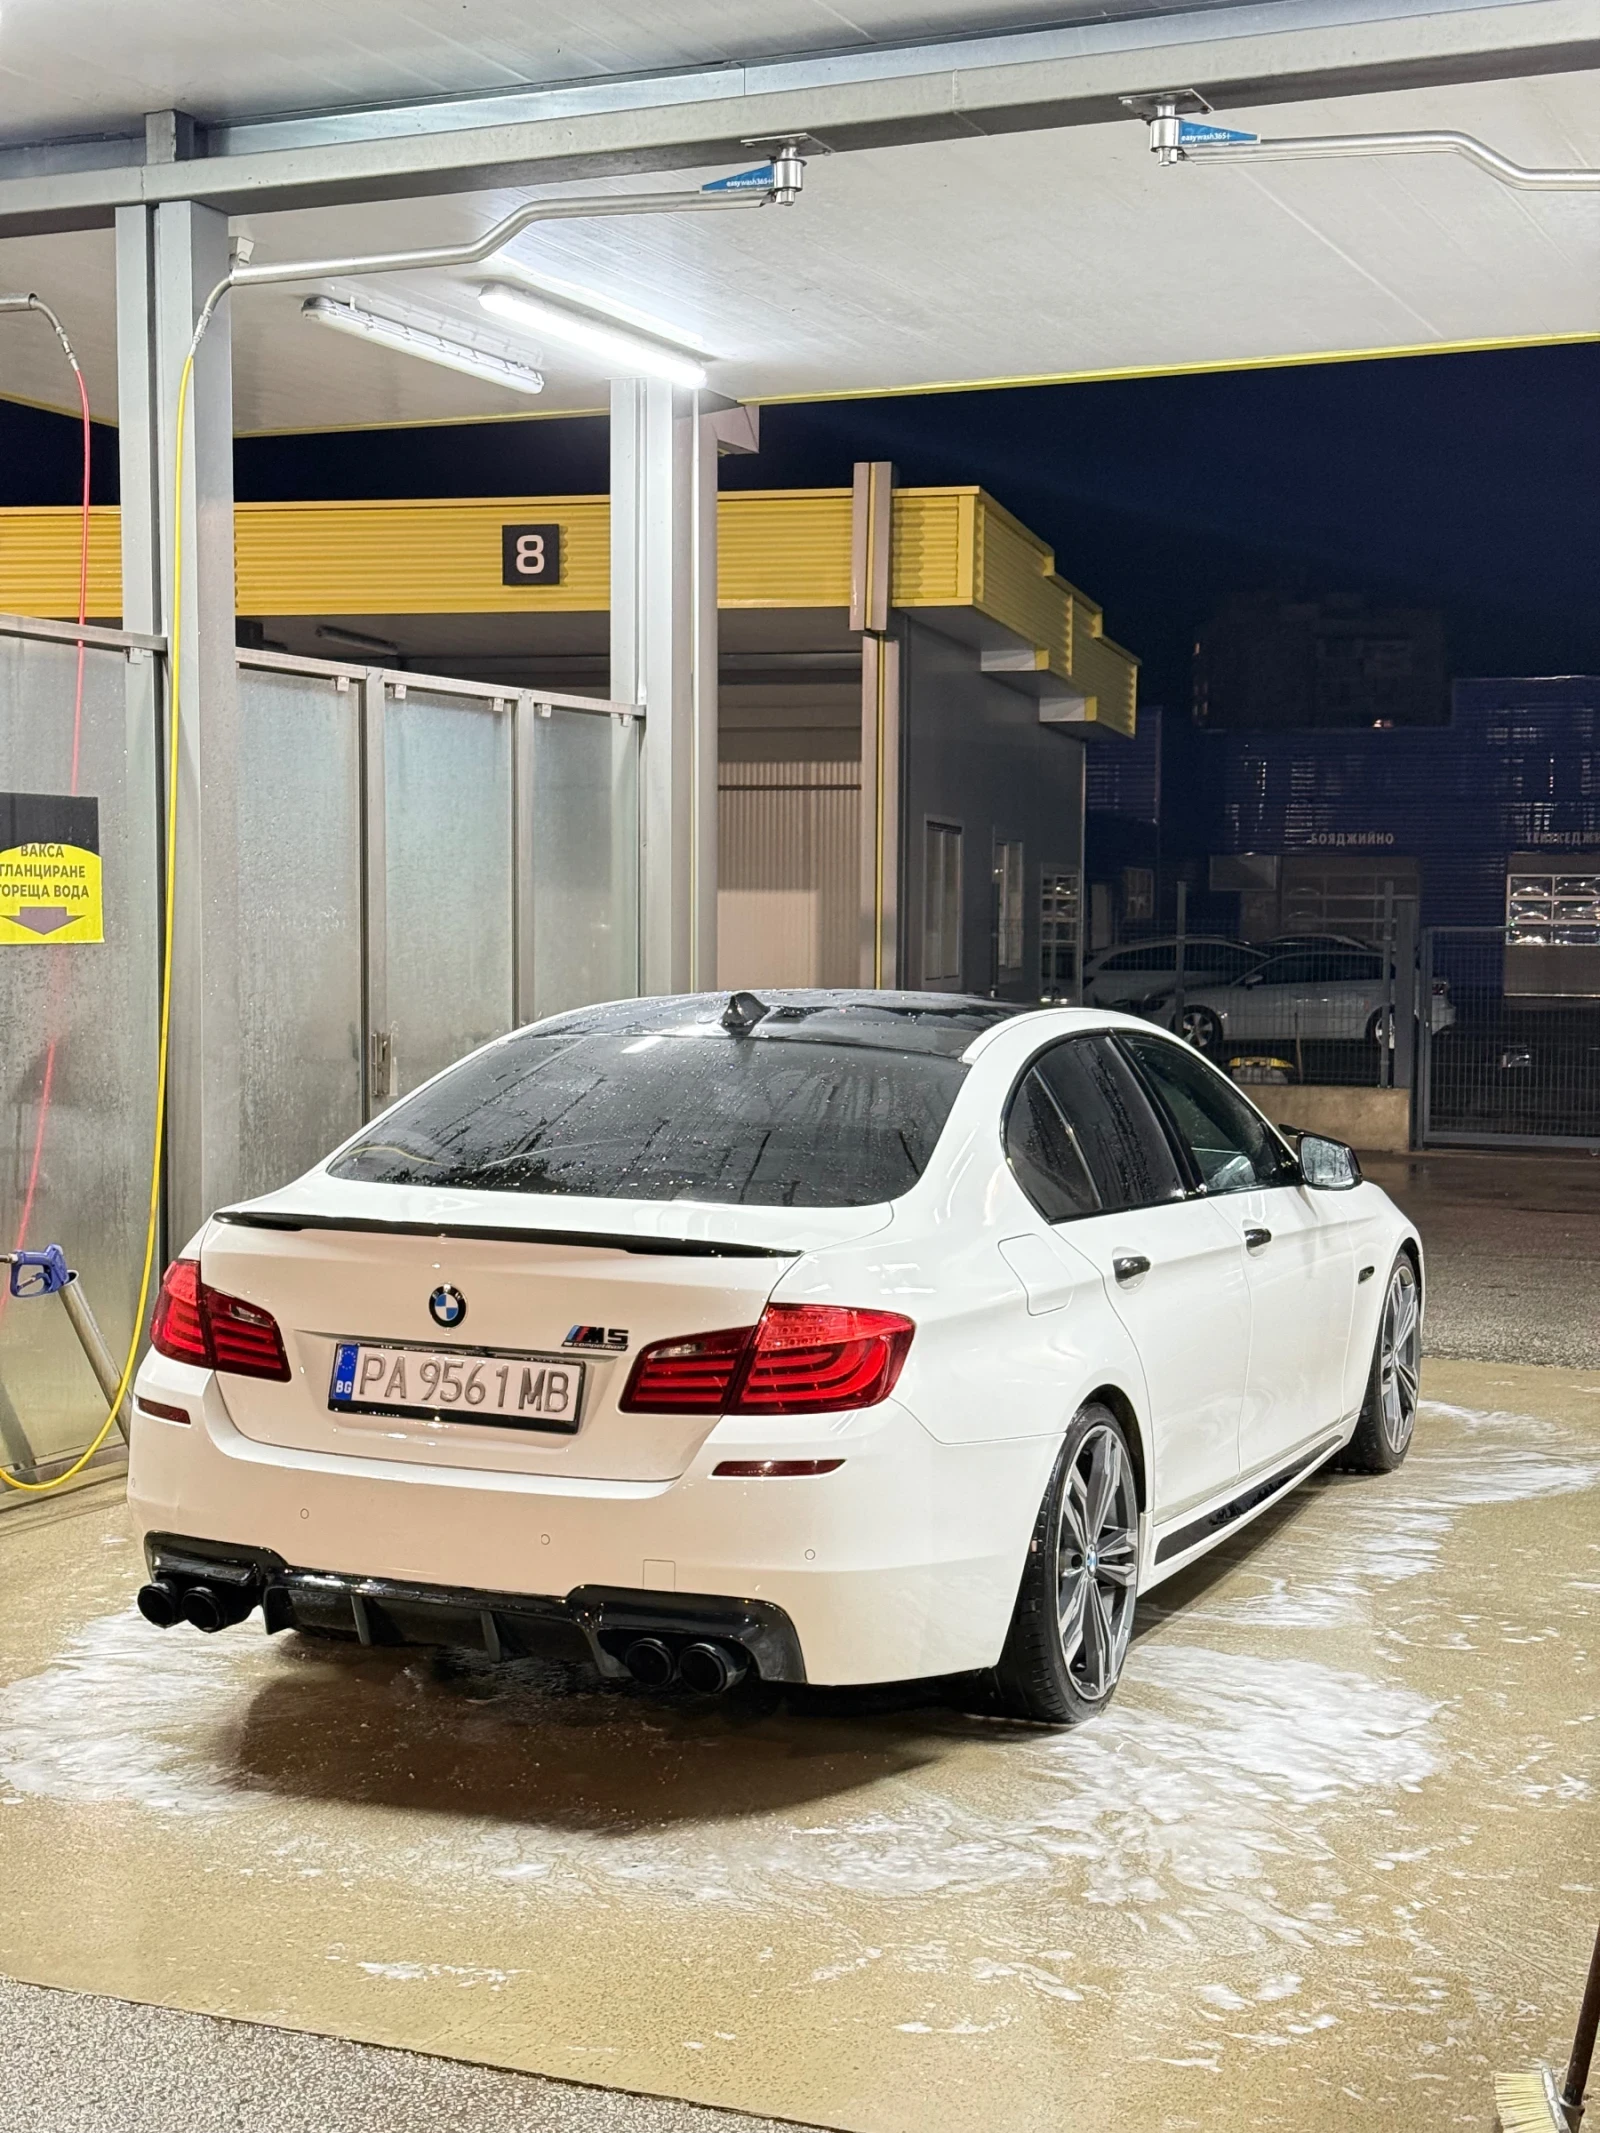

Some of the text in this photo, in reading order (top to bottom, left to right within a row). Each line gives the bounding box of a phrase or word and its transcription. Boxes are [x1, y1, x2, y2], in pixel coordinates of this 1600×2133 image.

[516, 534, 545, 575] 8
[1310, 831, 1395, 847] БОЯДЖИЙНО
[20, 844, 65, 859] ВАКСА
[0, 883, 90, 900] ОРЕЩА ВОДА
[335, 1379, 353, 1395] BG
[359, 1352, 570, 1413] PA 9561 MB
